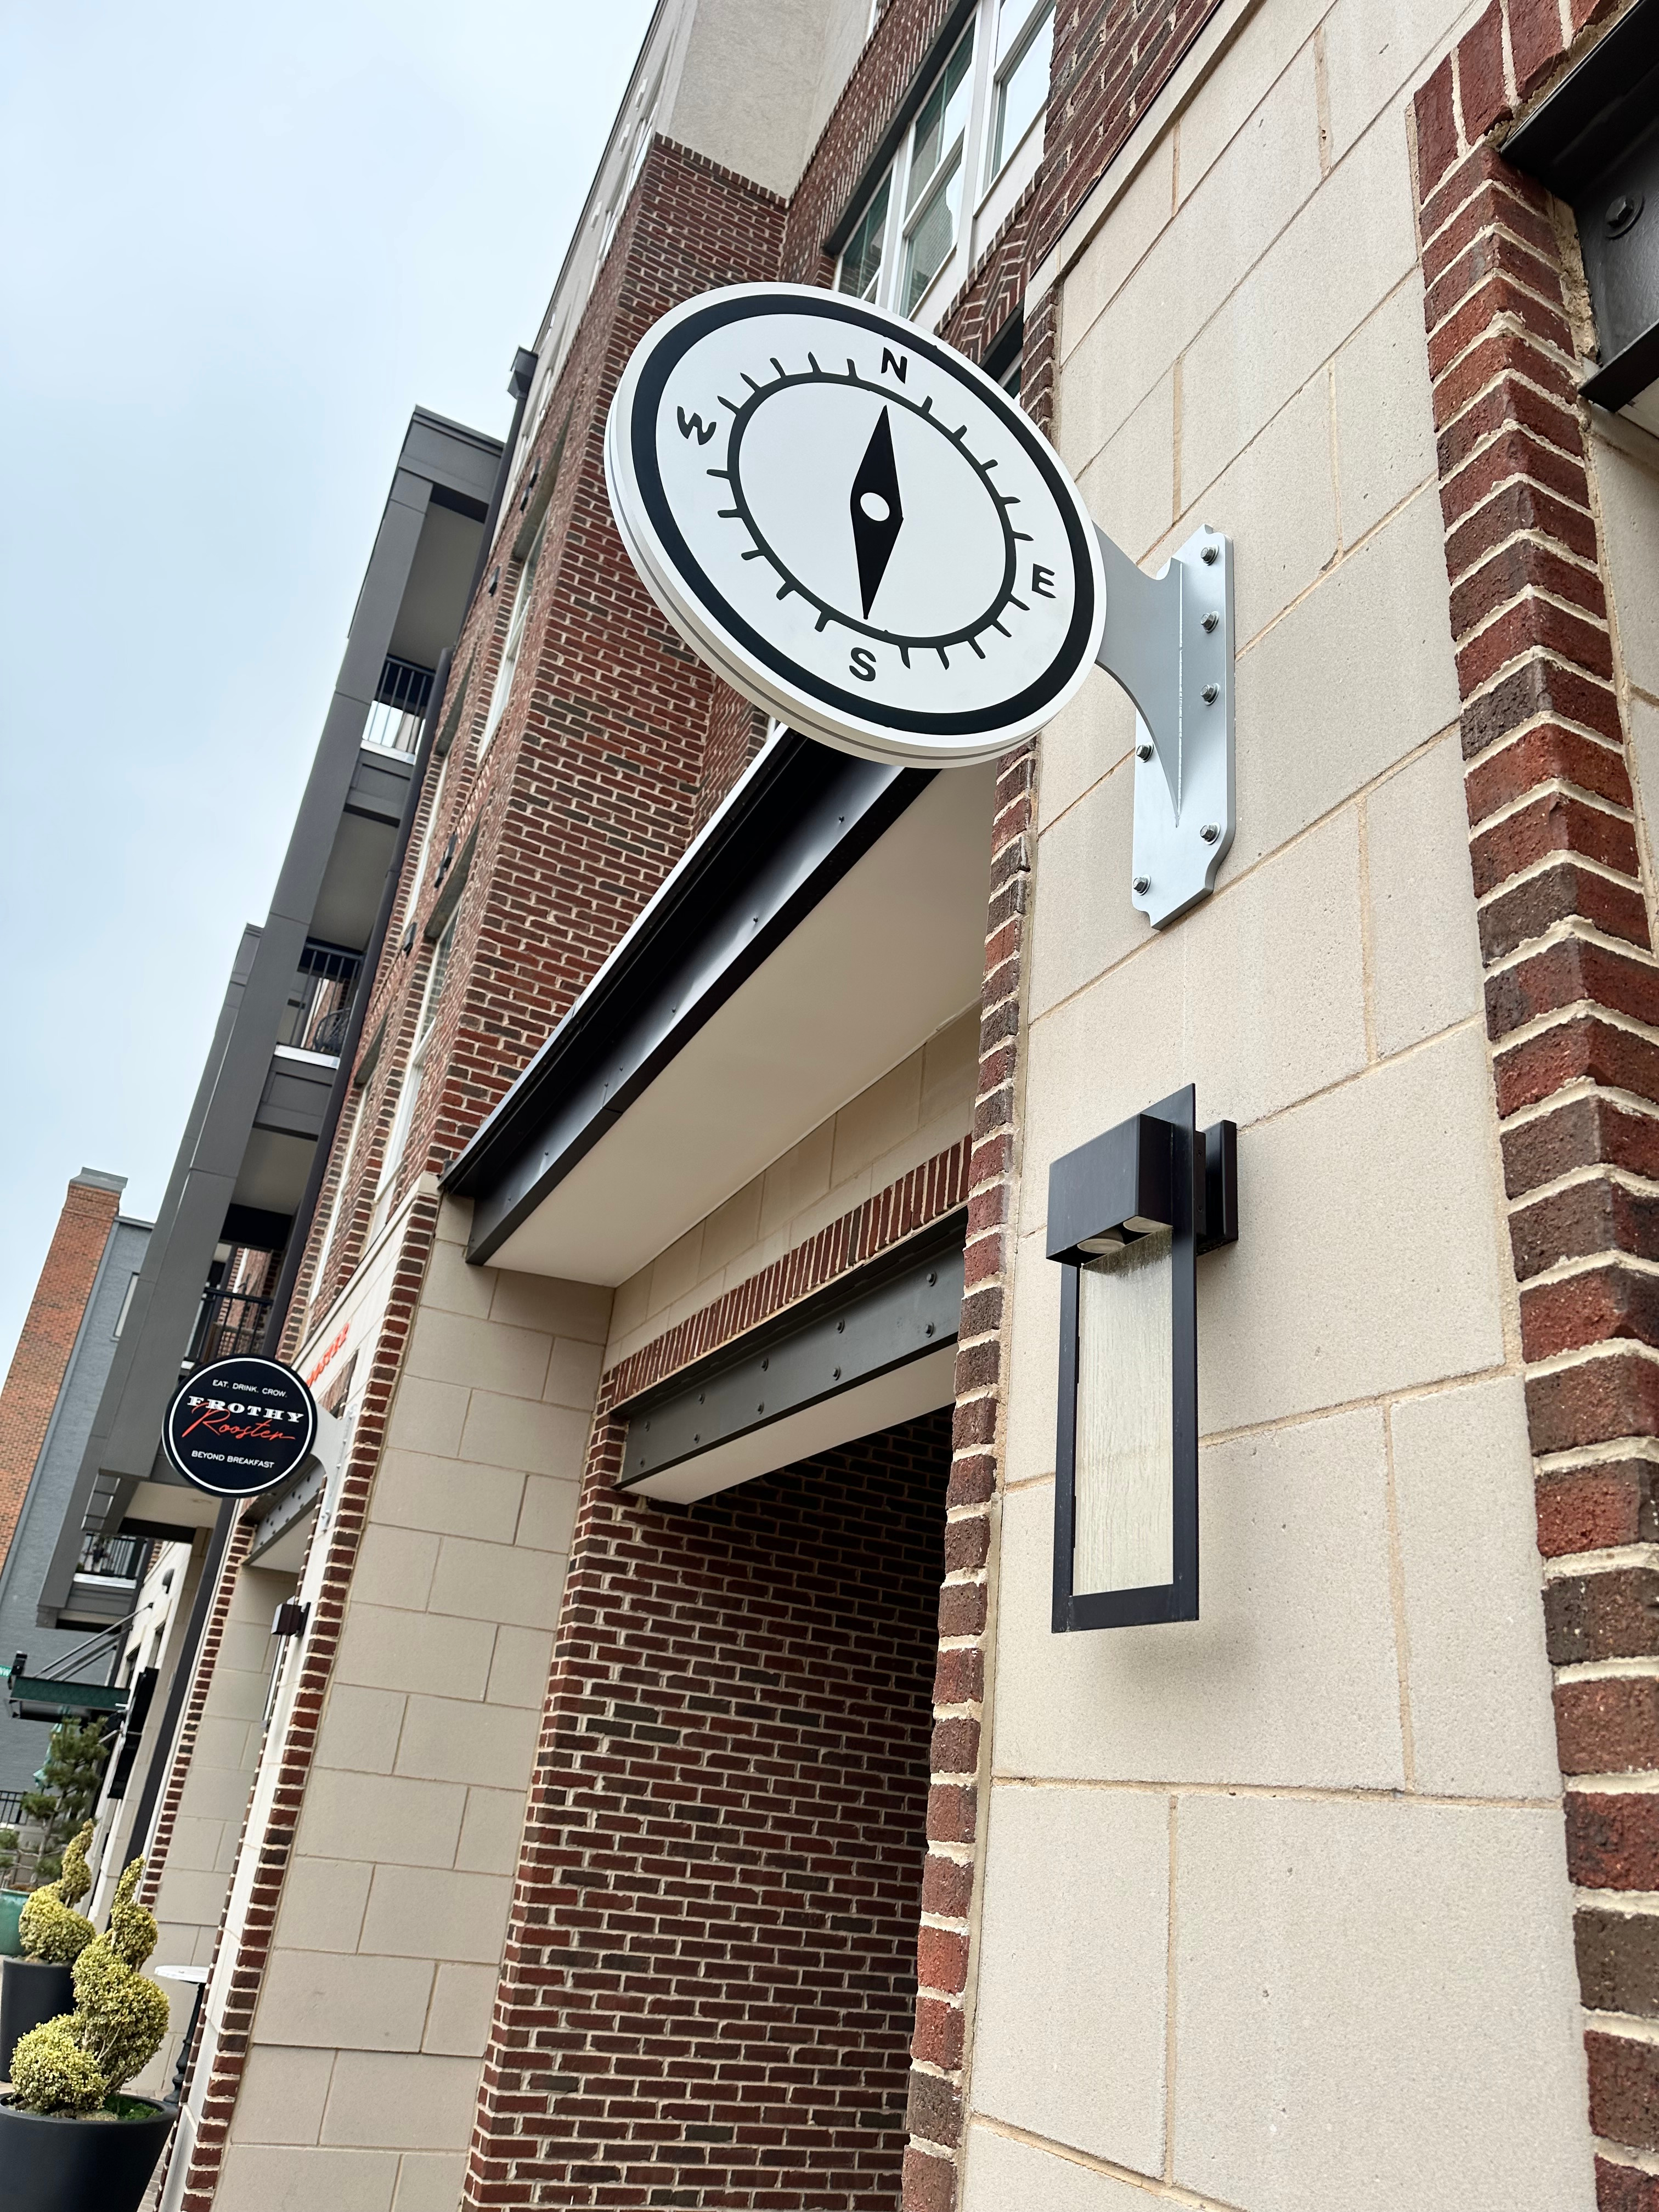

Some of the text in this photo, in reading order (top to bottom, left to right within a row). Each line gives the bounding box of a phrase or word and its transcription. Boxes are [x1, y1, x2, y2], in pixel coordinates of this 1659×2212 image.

[881, 347, 909, 385] N
[677, 405, 716, 445] W
[1031, 563, 1056, 599] E
[849, 647, 877, 682] S
[212, 1379, 287, 1397] EAT. DRINK. CROW.
[182, 1402, 296, 1441] Rooster
[187, 1396, 304, 1423] FROTHY
[191, 1450, 274, 1468] BEYOND BREAKFAST
